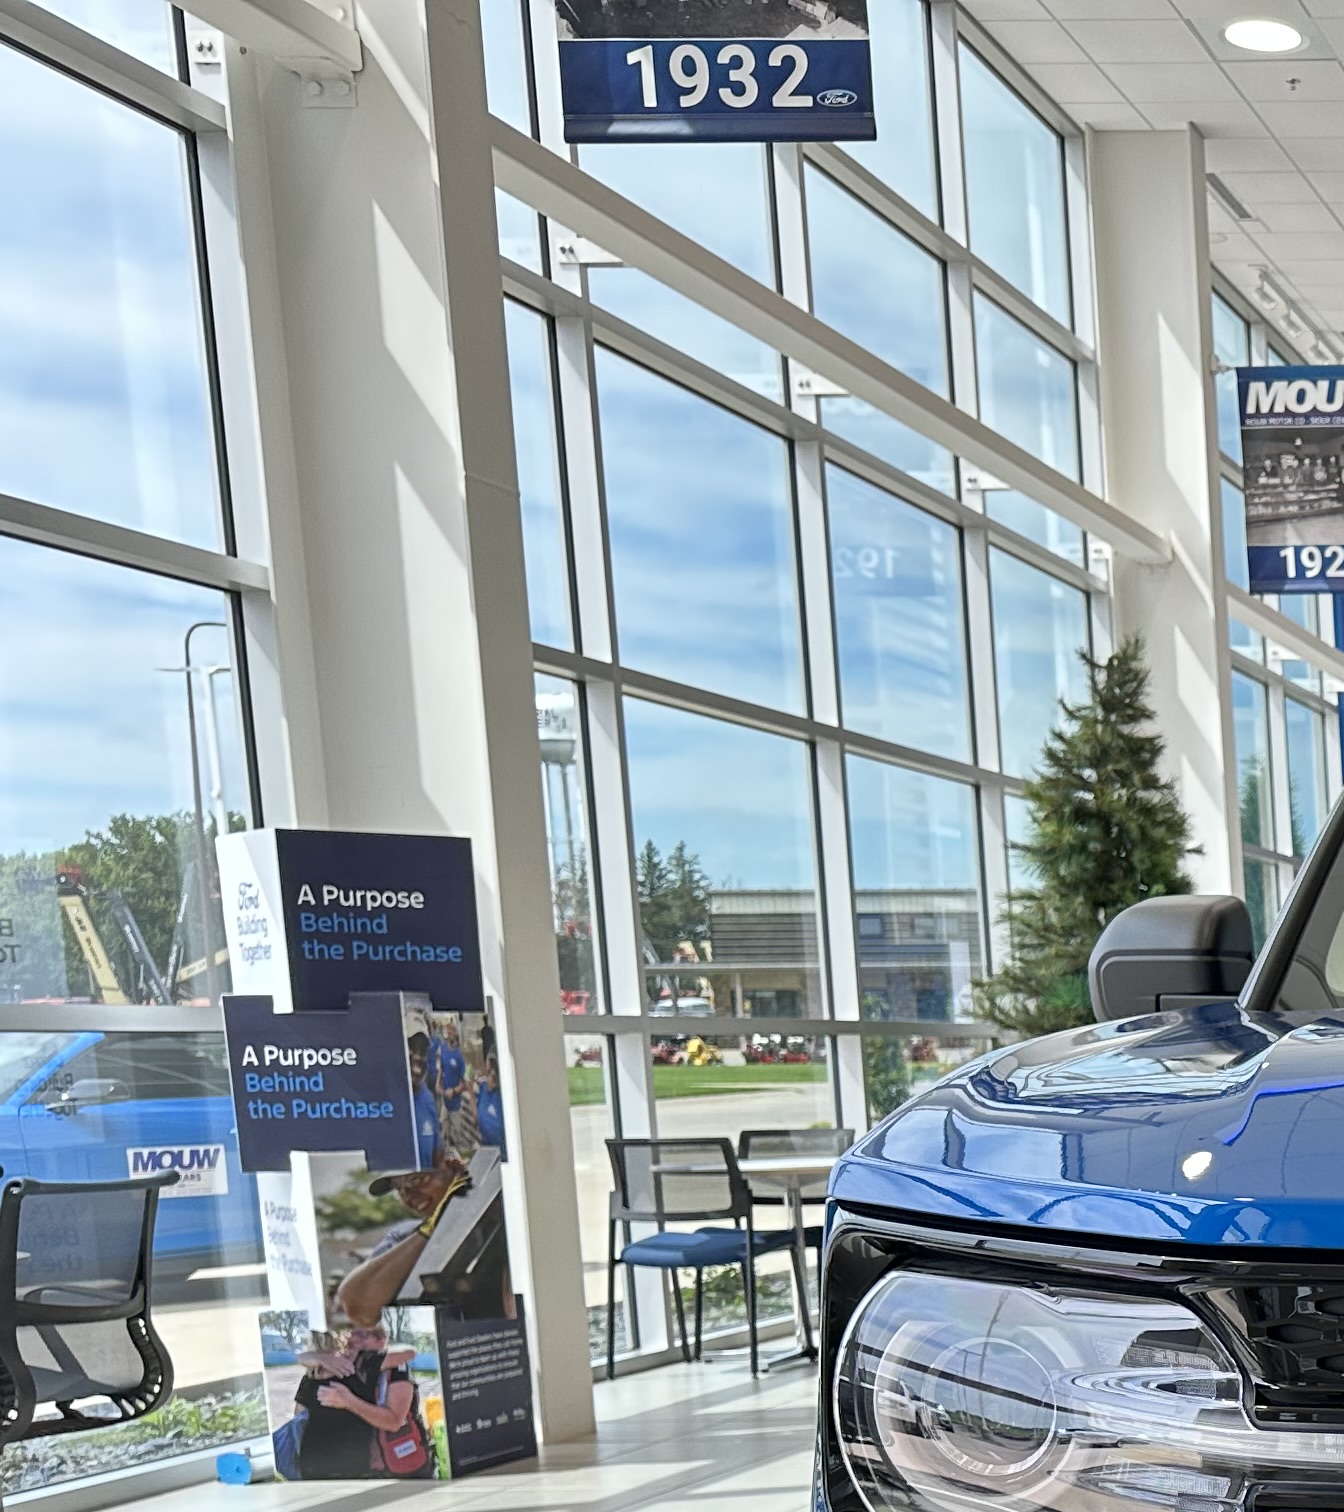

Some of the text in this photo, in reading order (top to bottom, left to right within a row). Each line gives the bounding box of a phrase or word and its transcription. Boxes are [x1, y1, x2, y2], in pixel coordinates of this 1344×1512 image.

[626, 44, 814, 108] 1932
[298, 884, 425, 911] A Purpose
[300, 911, 388, 934] Behind
[303, 939, 463, 963] the Purchase
[241, 1045, 357, 1070] A Purpose
[244, 1071, 325, 1093] Behind
[247, 1097, 394, 1120] the Purchase
[132, 1147, 220, 1174] MOUW
